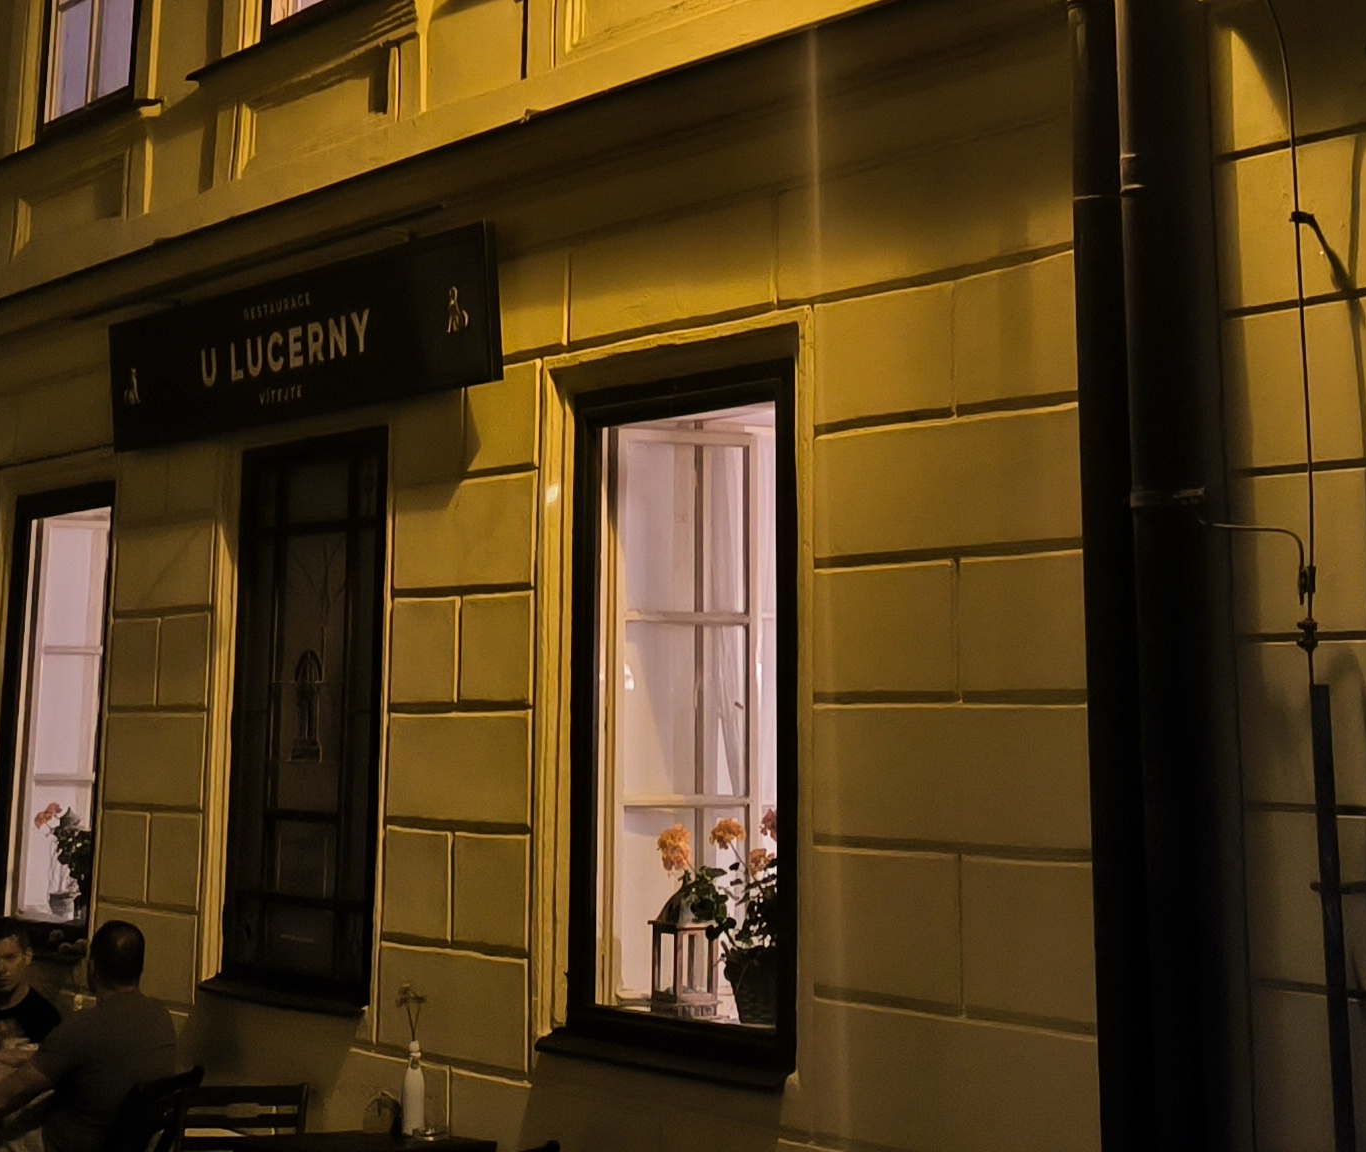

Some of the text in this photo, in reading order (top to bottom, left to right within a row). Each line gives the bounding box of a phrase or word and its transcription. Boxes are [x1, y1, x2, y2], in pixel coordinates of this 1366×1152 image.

[243, 292, 311, 321] RESTAURACE
[200, 308, 370, 388] U LUCERNY
